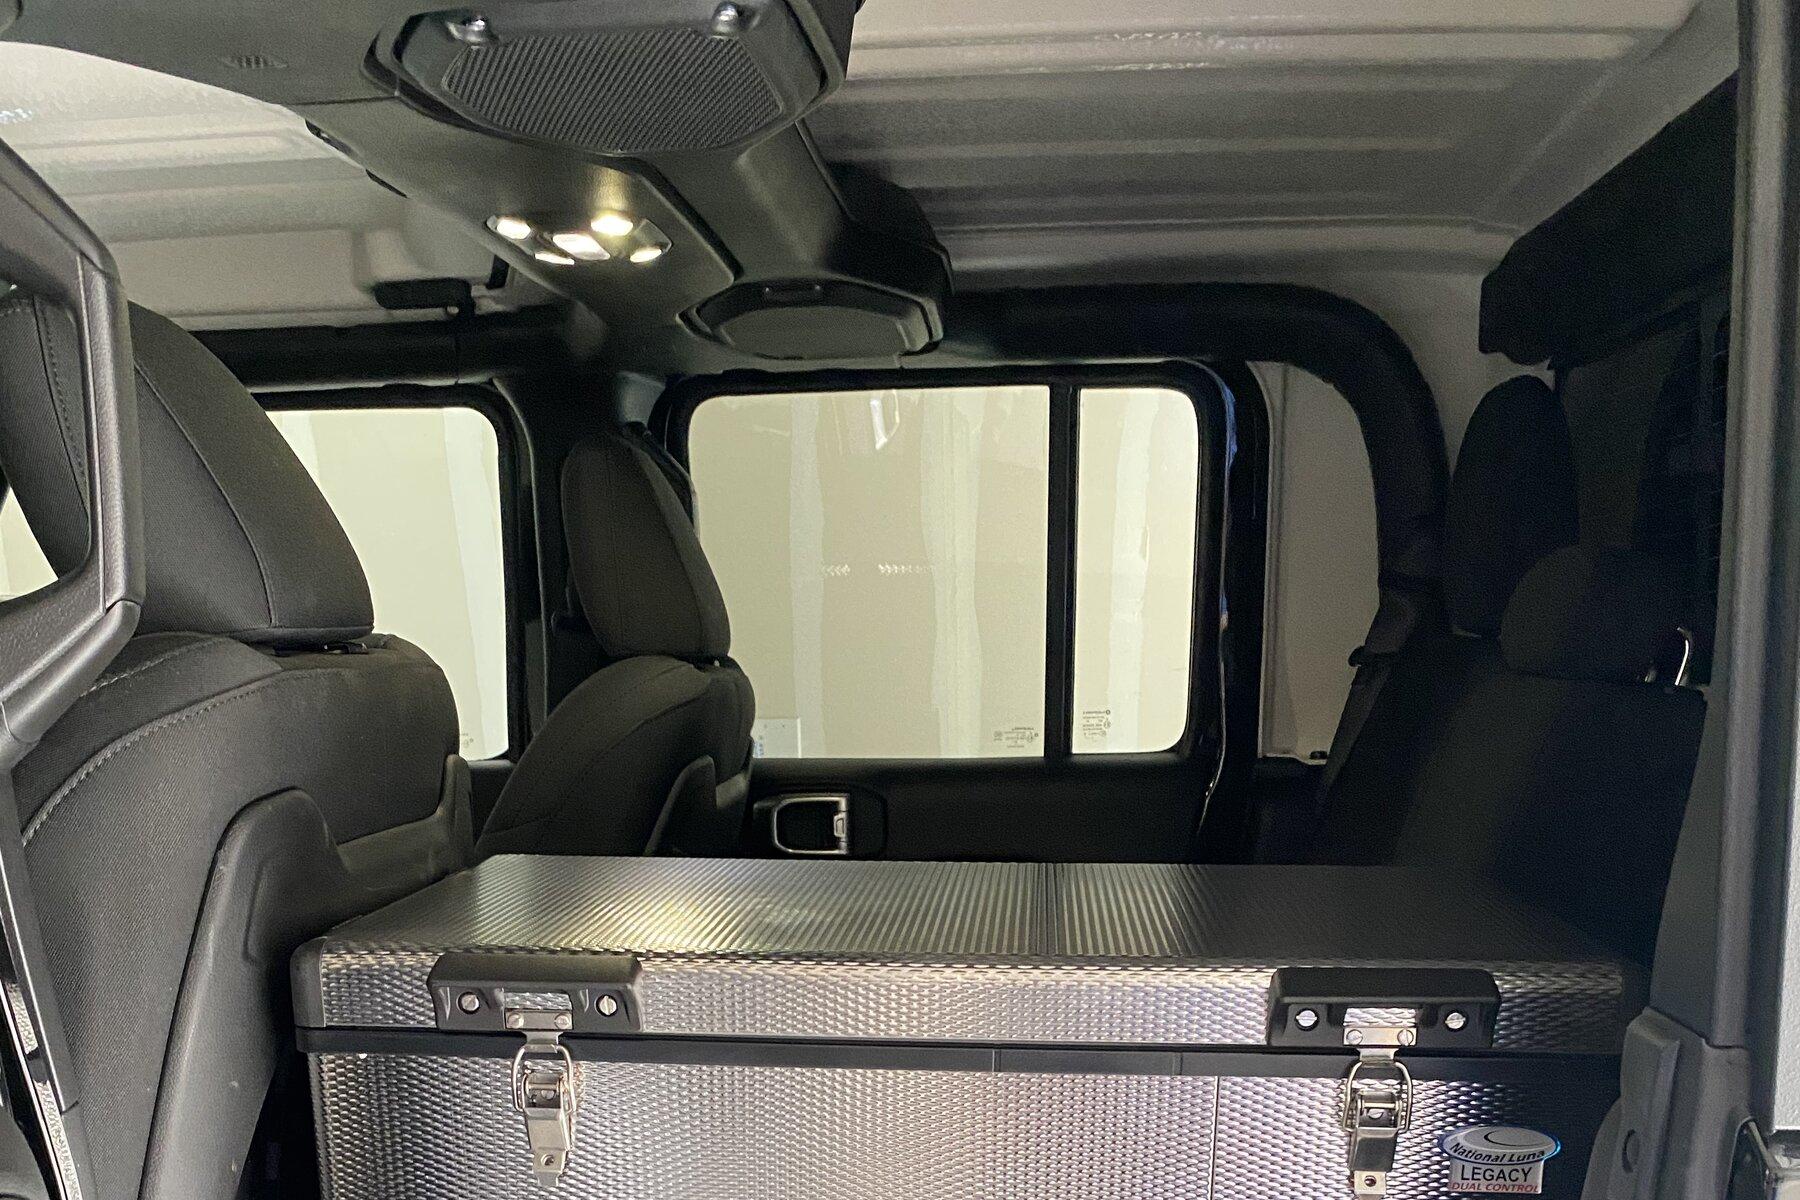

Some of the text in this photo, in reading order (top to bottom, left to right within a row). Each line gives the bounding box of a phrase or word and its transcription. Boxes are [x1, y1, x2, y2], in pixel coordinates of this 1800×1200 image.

[1450, 1142, 1545, 1162] National Luna
[1461, 1164, 1532, 1182] LEGACY
[1451, 1182, 1539, 1193] DUAL CONTROL
